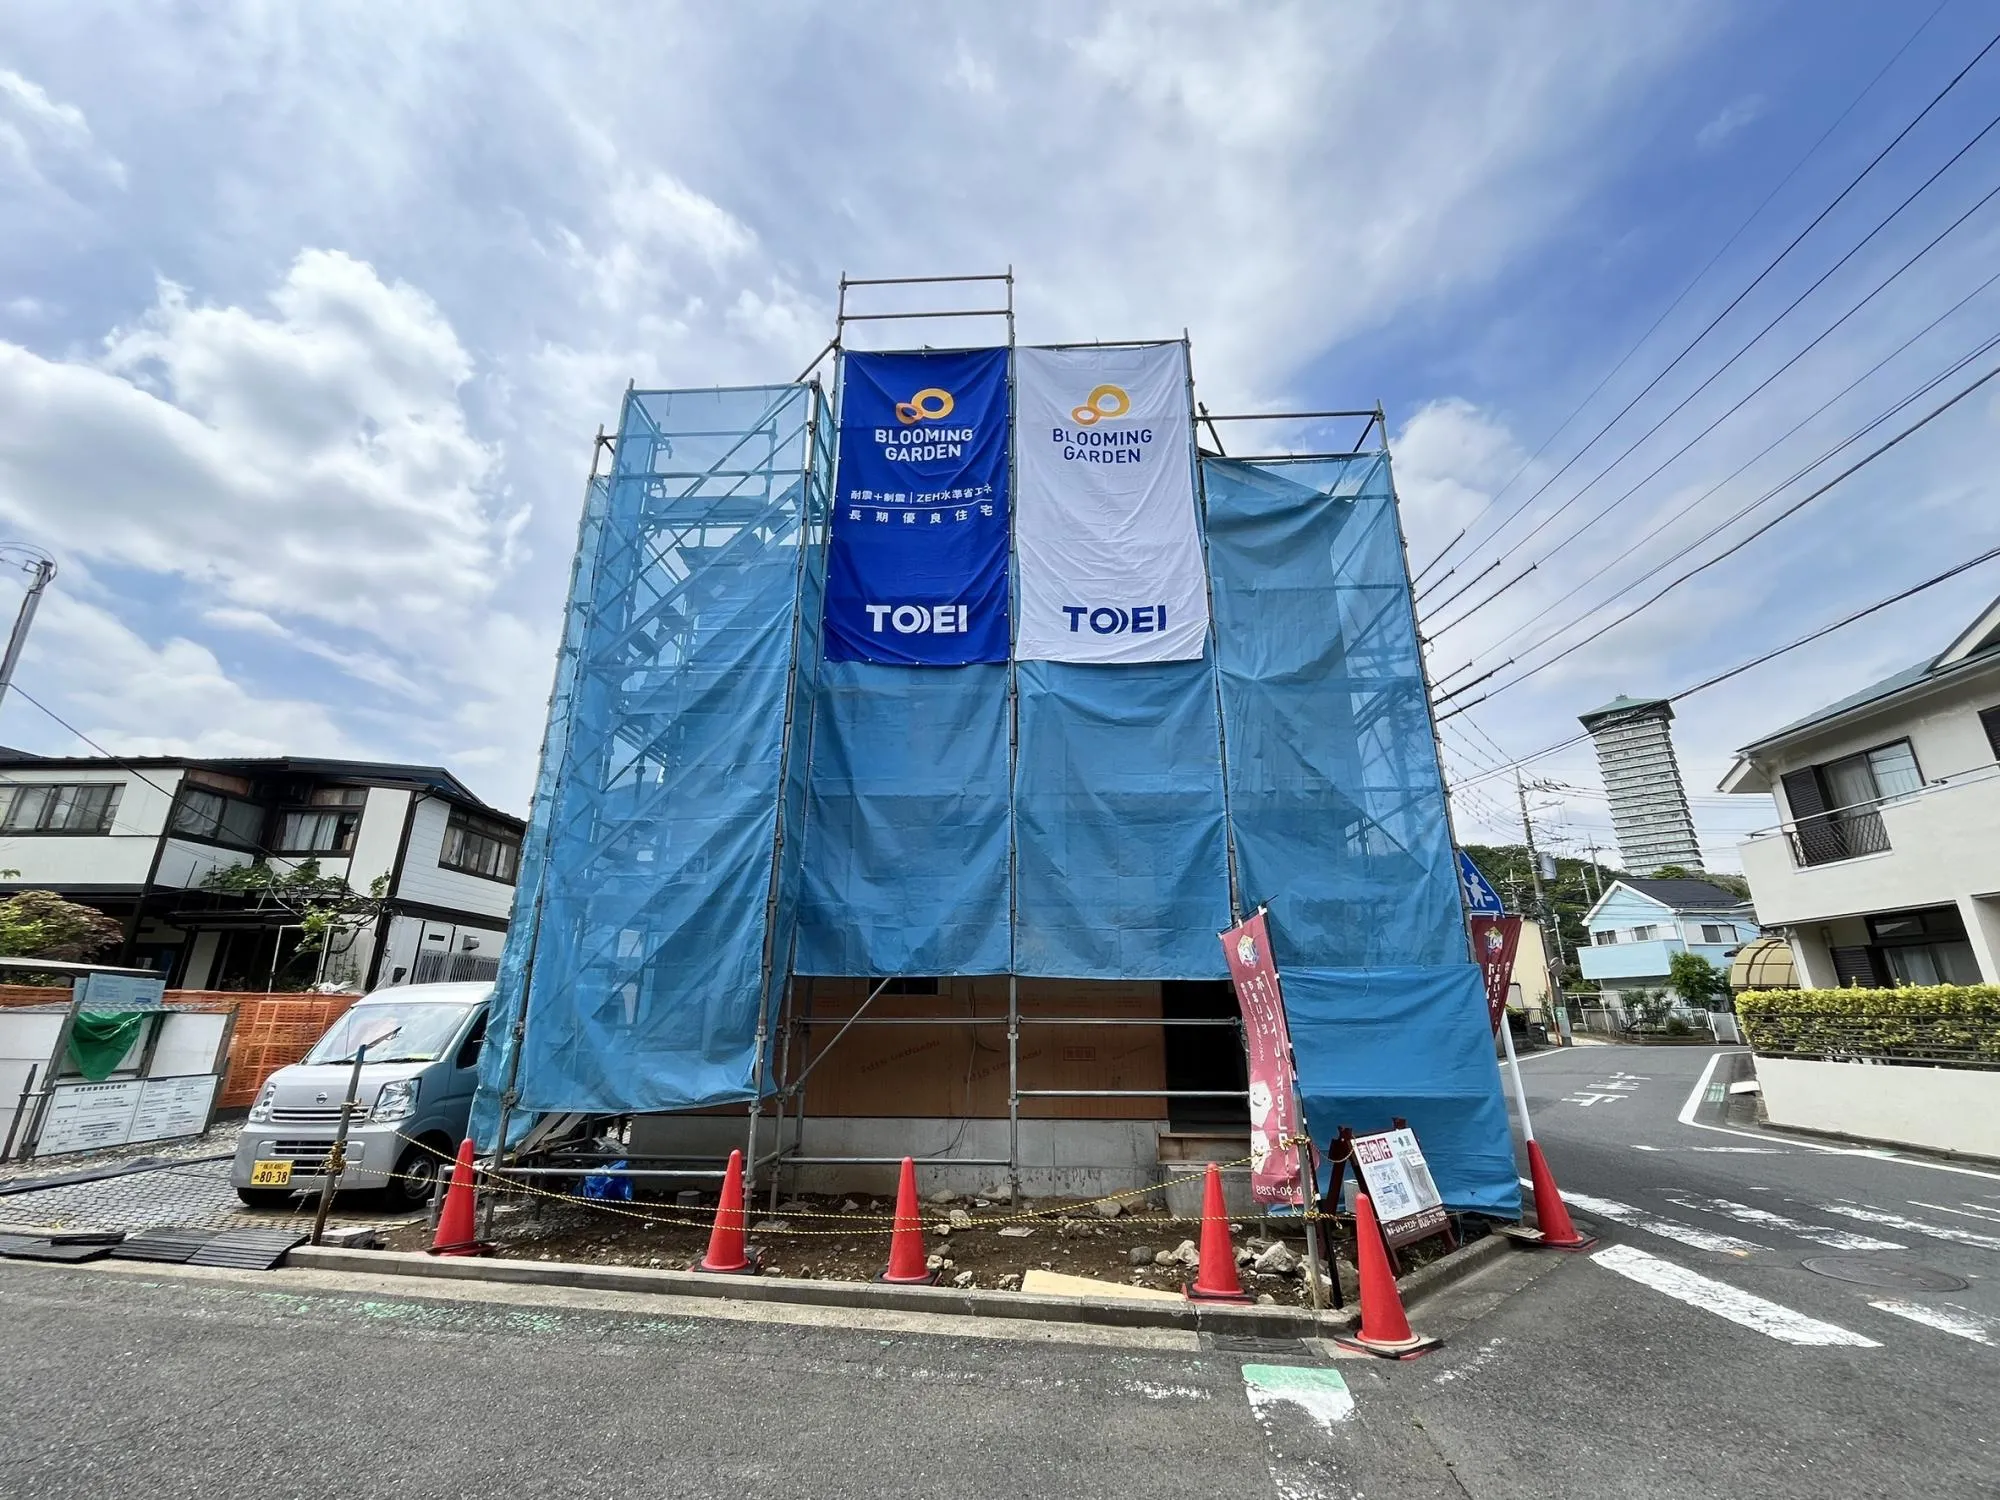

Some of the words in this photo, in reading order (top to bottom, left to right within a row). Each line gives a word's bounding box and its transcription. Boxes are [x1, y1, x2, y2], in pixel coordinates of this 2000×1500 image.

[875, 428, 973, 445] BLOOMING
[1052, 428, 1152, 446] BLOOMING
[885, 444, 962, 462] GARDEN
[1063, 445, 1141, 464] GARDEN
[849, 505, 993, 524] 長期優良住宅
[1356, 1137, 1394, 1165] 売物件
[259, 1170, 288, 1183] 80-38
